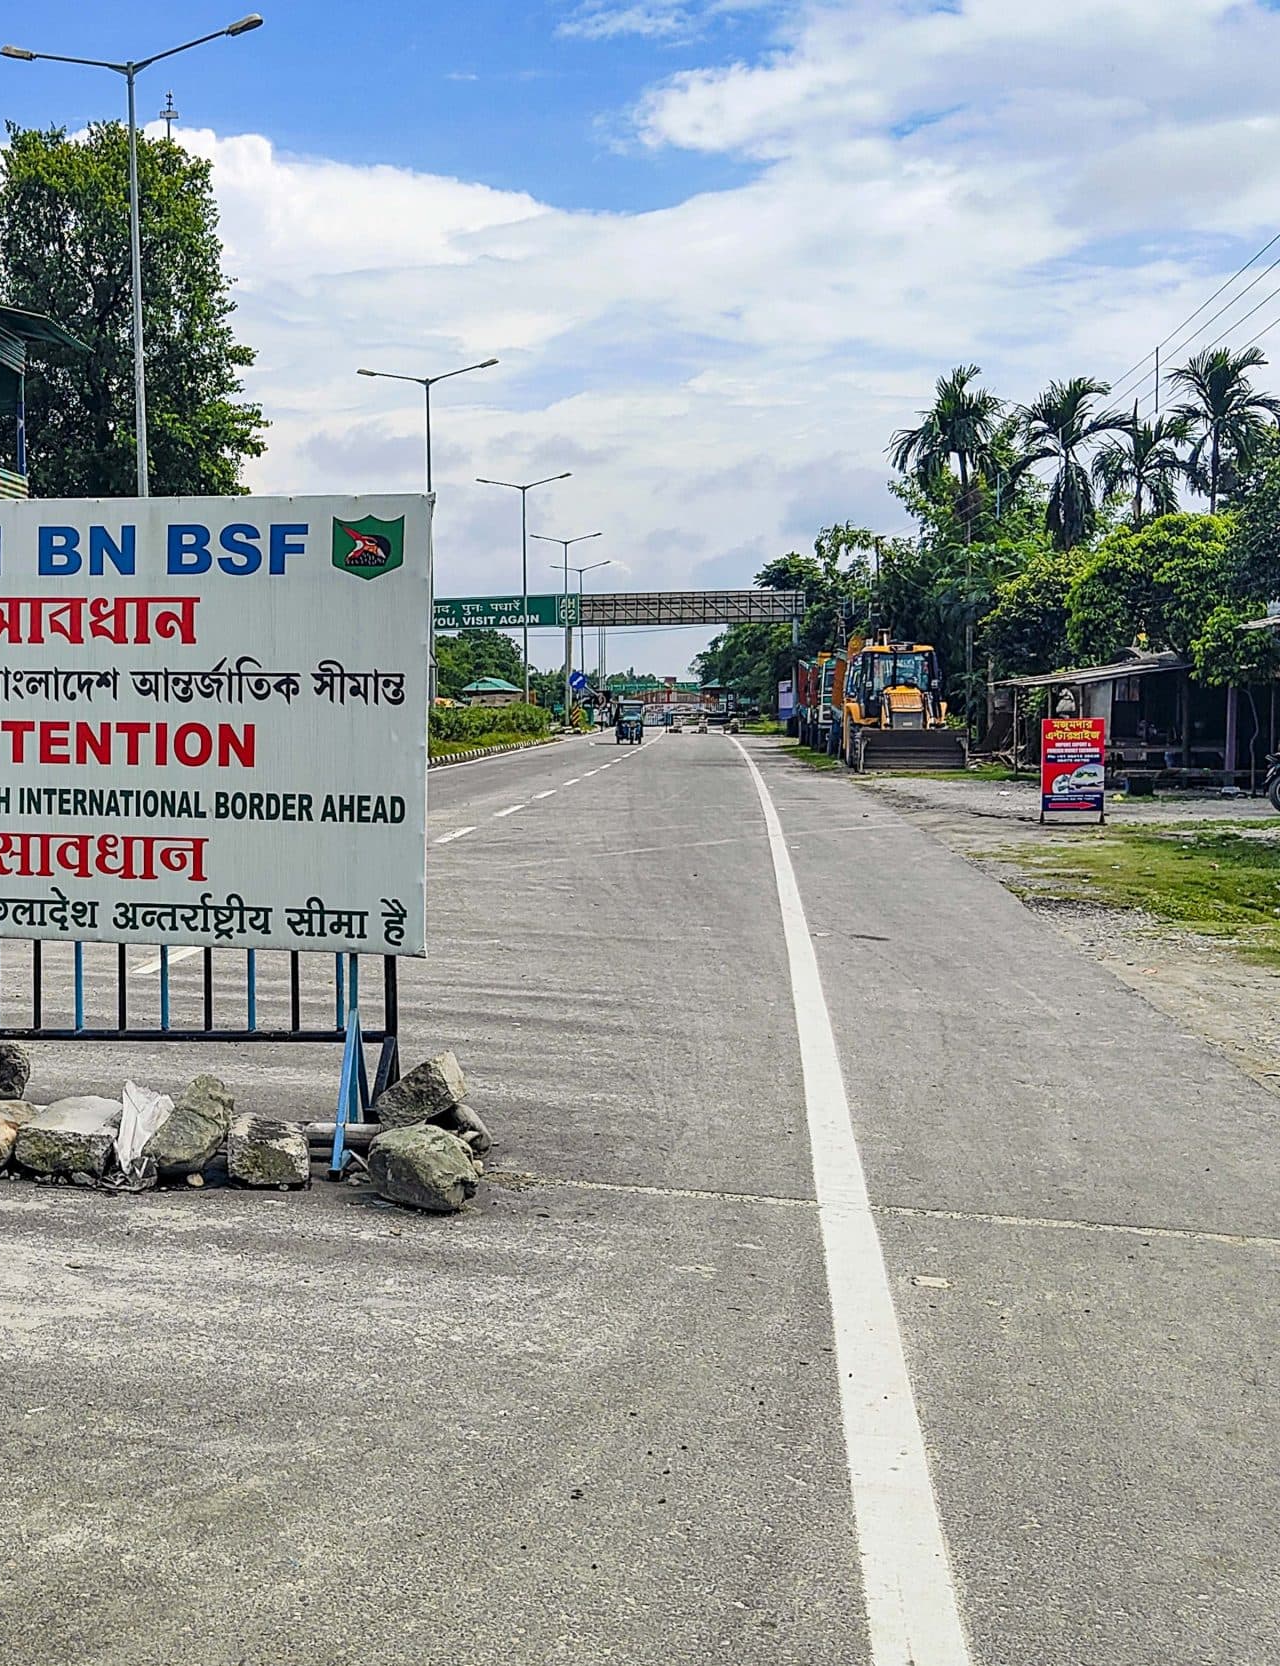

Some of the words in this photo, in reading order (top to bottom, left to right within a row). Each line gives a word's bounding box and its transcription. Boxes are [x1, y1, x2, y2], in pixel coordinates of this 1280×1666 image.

[38, 524, 136, 577] BN
[167, 523, 309, 577] BSF
[462, 616, 496, 626] VISIT
[499, 614, 540, 625] AGAIN
[560, 598, 575, 609] AH
[560, 609, 576, 620] 02
[129, 656, 301, 705] আন্তর্জাতিক
[311, 659, 406, 706] সীমান্ত
[19, 787, 206, 819] INTERNATIONAL
[215, 791, 314, 822] BORDER
[320, 794, 406, 824] AHEAD
[112, 892, 273, 940] अन्तर्राष्ट्रीय
[285, 896, 369, 939] सीमा
[380, 898, 408, 946] है
